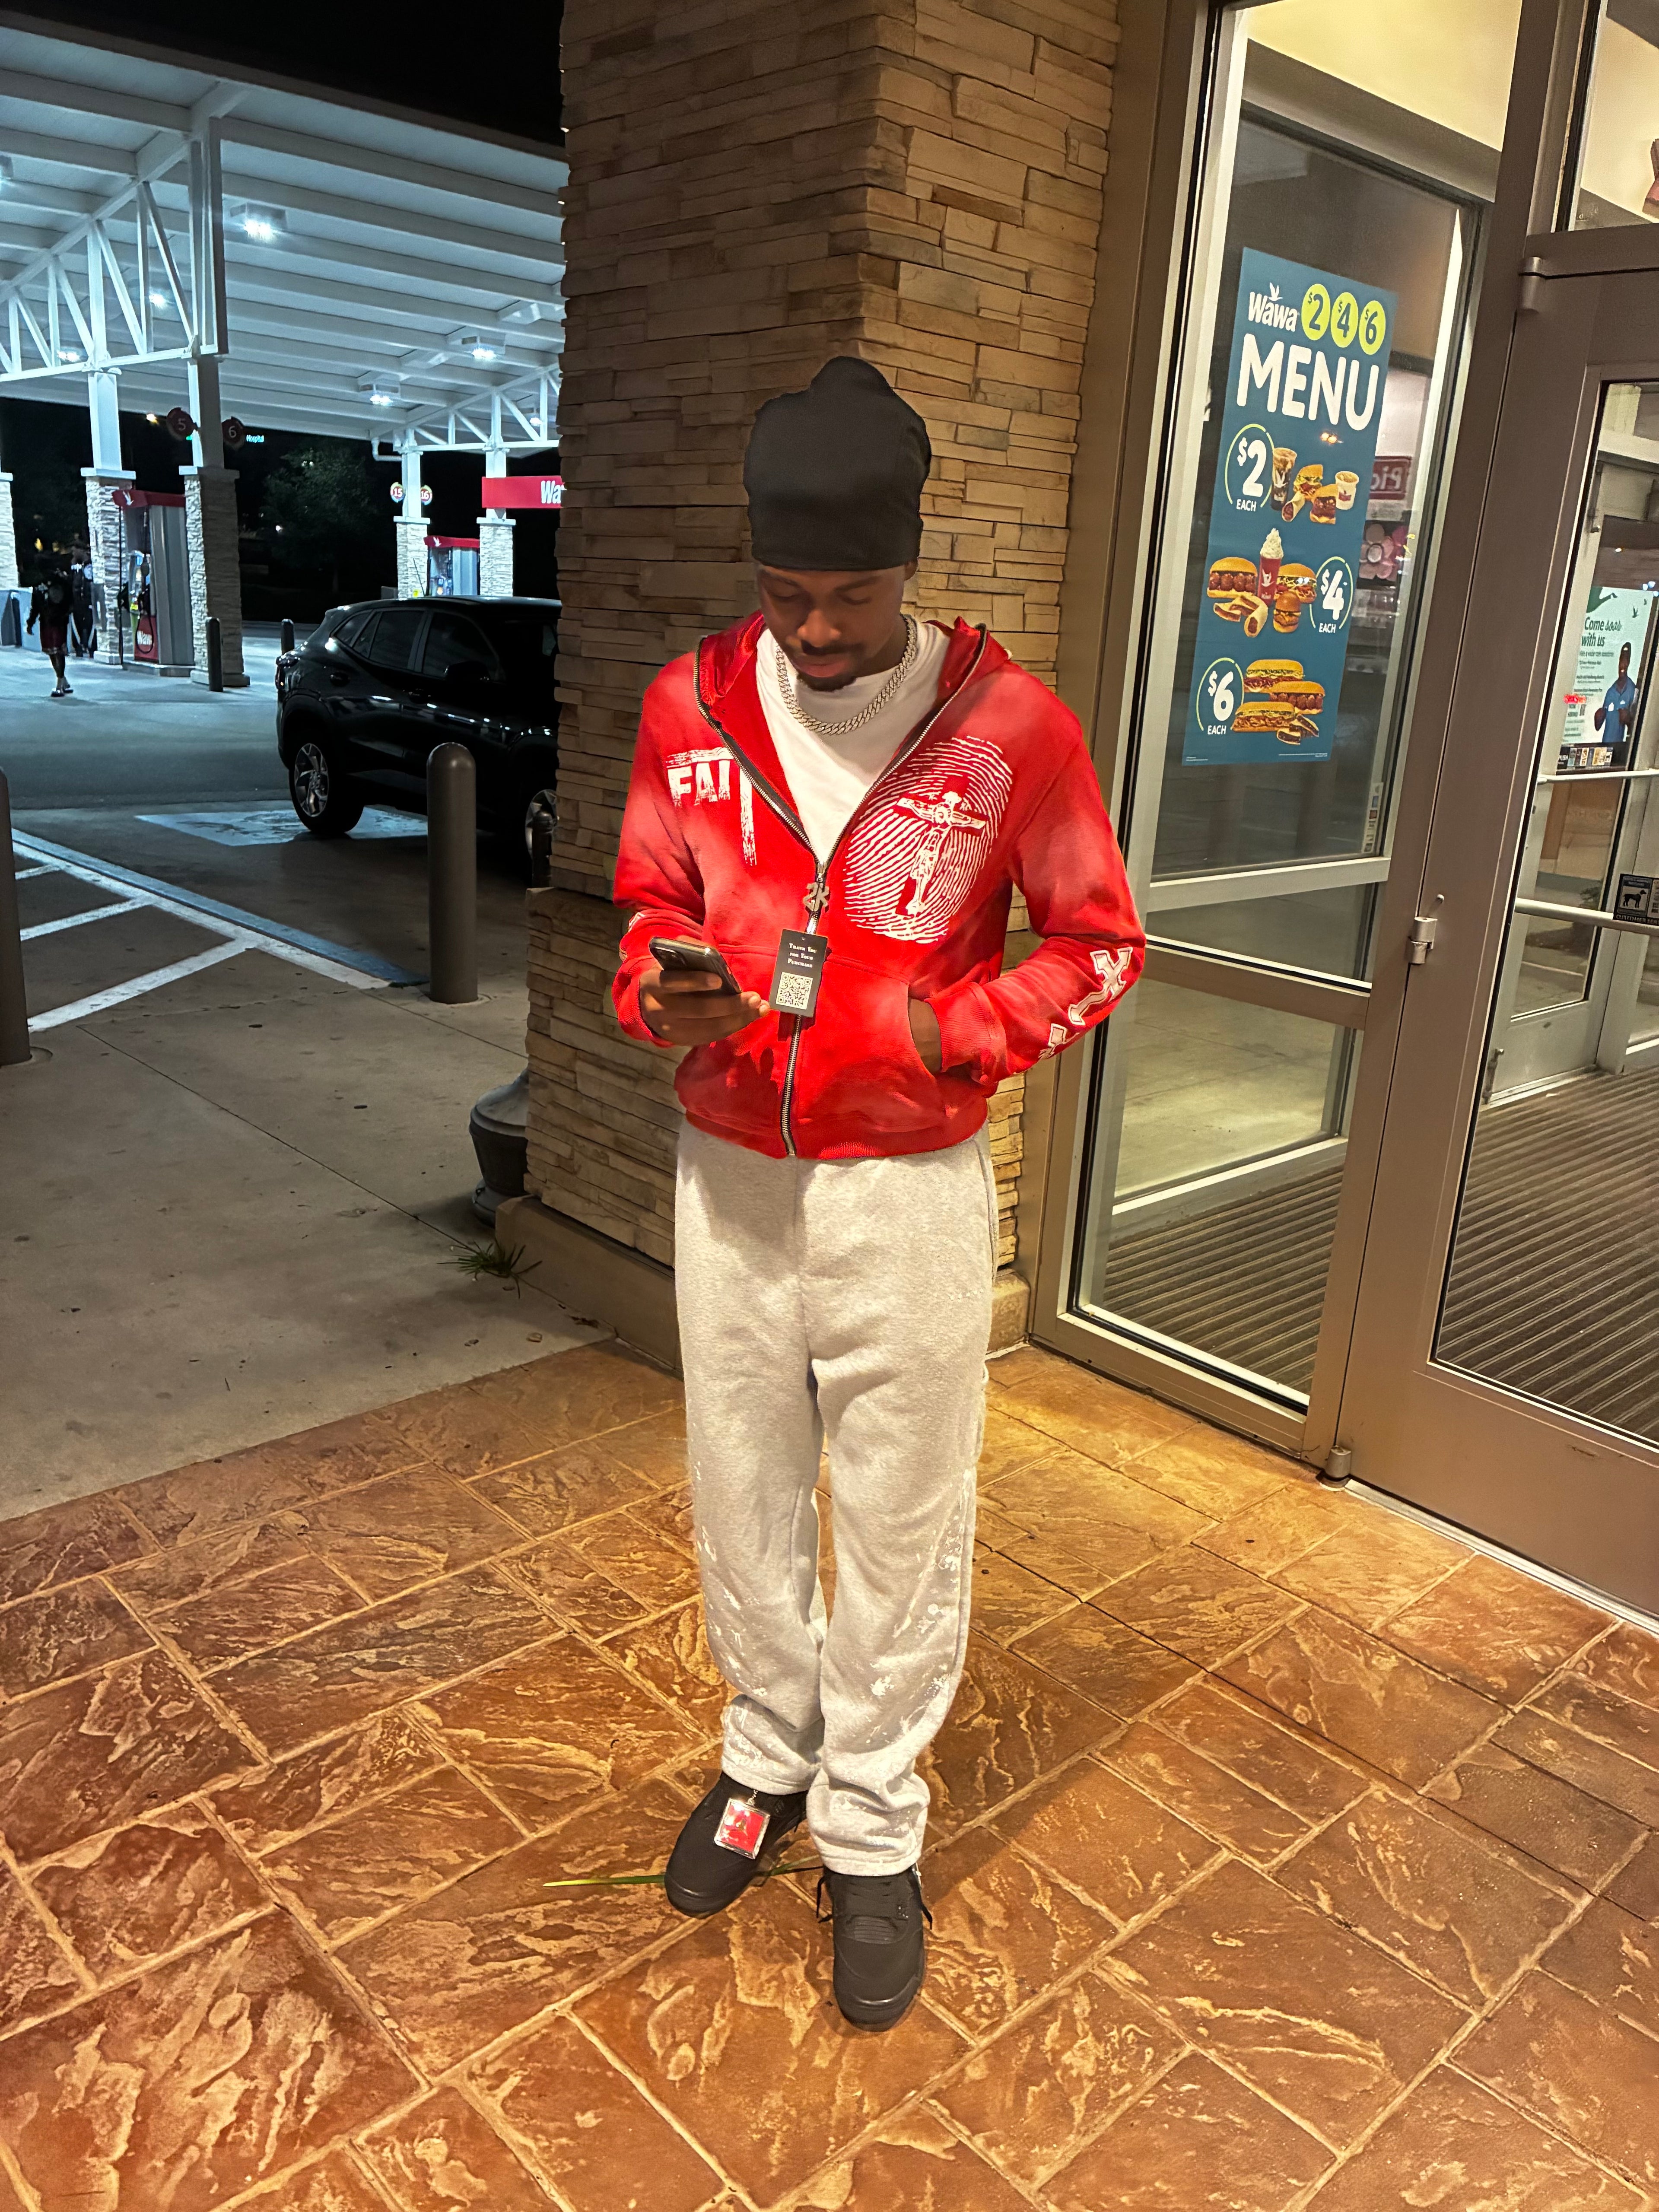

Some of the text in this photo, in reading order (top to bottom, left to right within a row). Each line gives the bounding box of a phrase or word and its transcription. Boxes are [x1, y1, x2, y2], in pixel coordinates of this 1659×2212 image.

[1248, 291, 1379, 345] Wawa $2 $4 $6
[1236, 333, 1379, 431] MENU
[177, 417, 187, 431] 5
[228, 425, 237, 438] 6
[1237, 437, 1267, 497] $2
[393, 487, 403, 497] 15
[420, 490, 429, 500] 16
[1236, 498, 1257, 512] EACH
[1321, 569, 1344, 620] $4
[1319, 623, 1336, 633] EACH
[1584, 617, 1605, 631] Come
[1581, 632, 1605, 647] with us
[1208, 671, 1234, 721] $6
[1208, 725, 1227, 735] EACH
